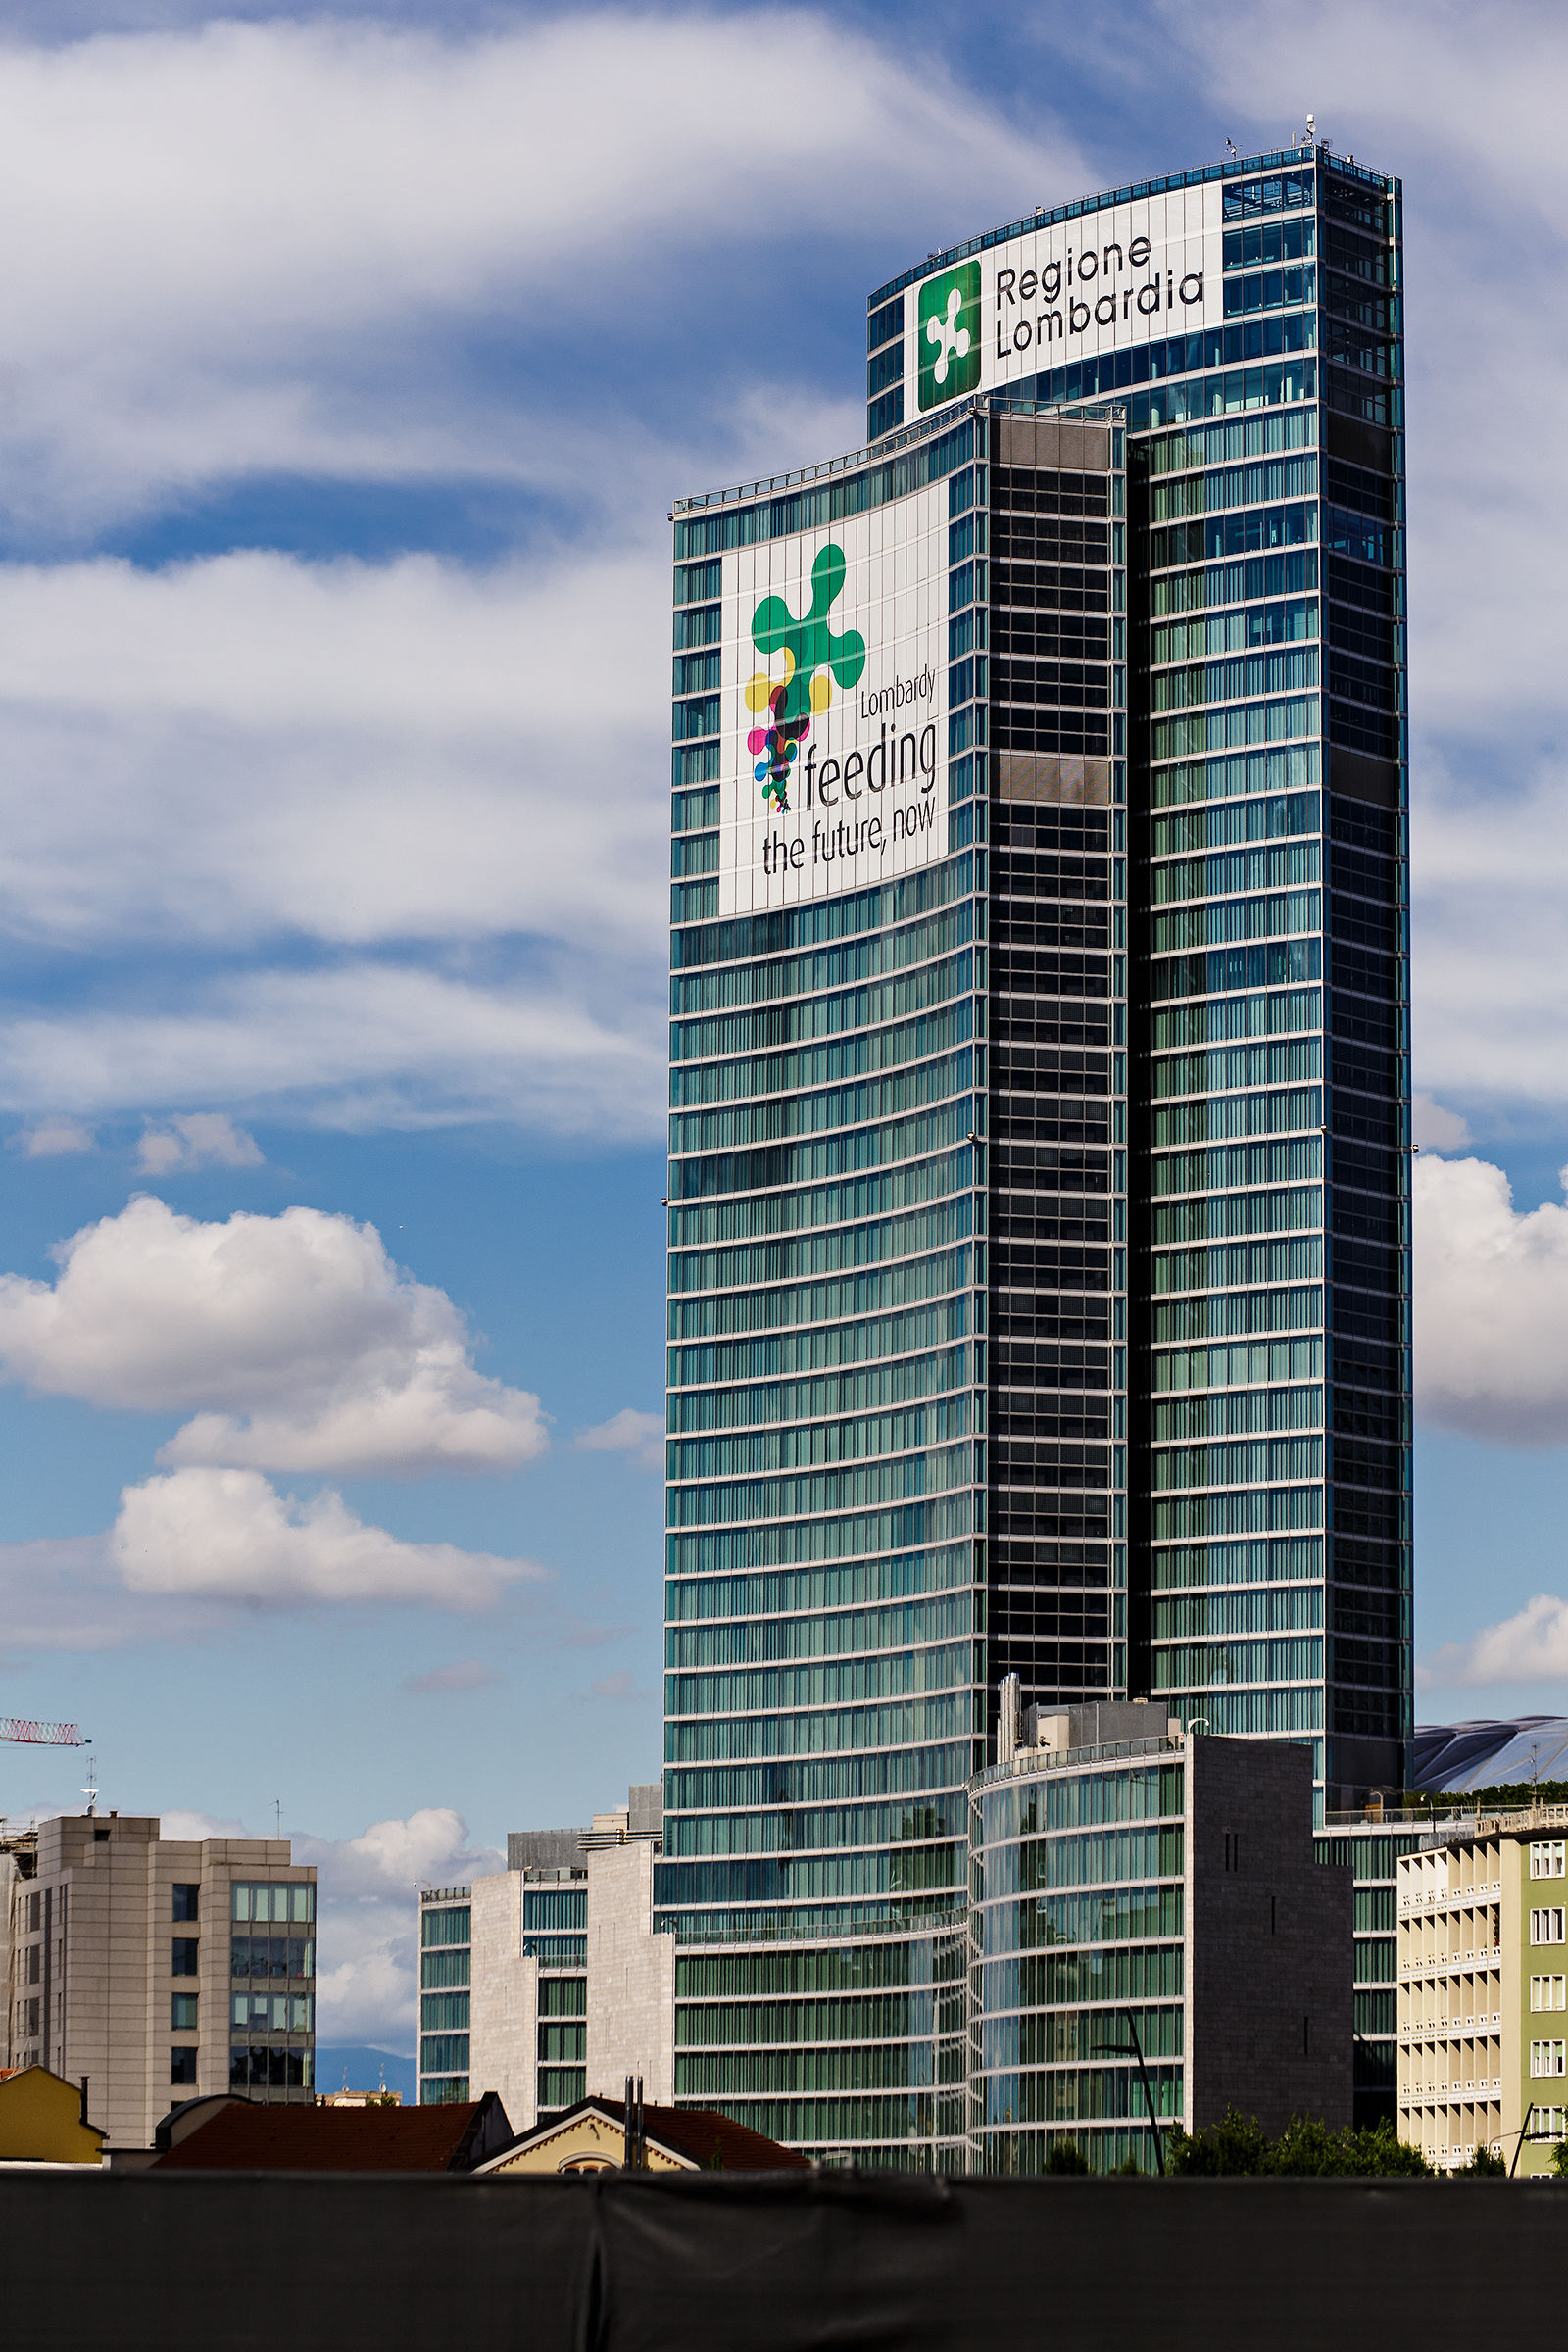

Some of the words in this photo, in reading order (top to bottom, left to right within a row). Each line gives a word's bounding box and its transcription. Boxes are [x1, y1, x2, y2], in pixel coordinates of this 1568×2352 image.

[997, 236, 1152, 310] Regione
[997, 270, 1204, 360] Lombardia
[861, 663, 936, 719] Lombardy
[804, 722, 936, 811] feeding
[762, 831, 805, 875] the
[812, 817, 887, 864] future,
[893, 797, 936, 842] now
